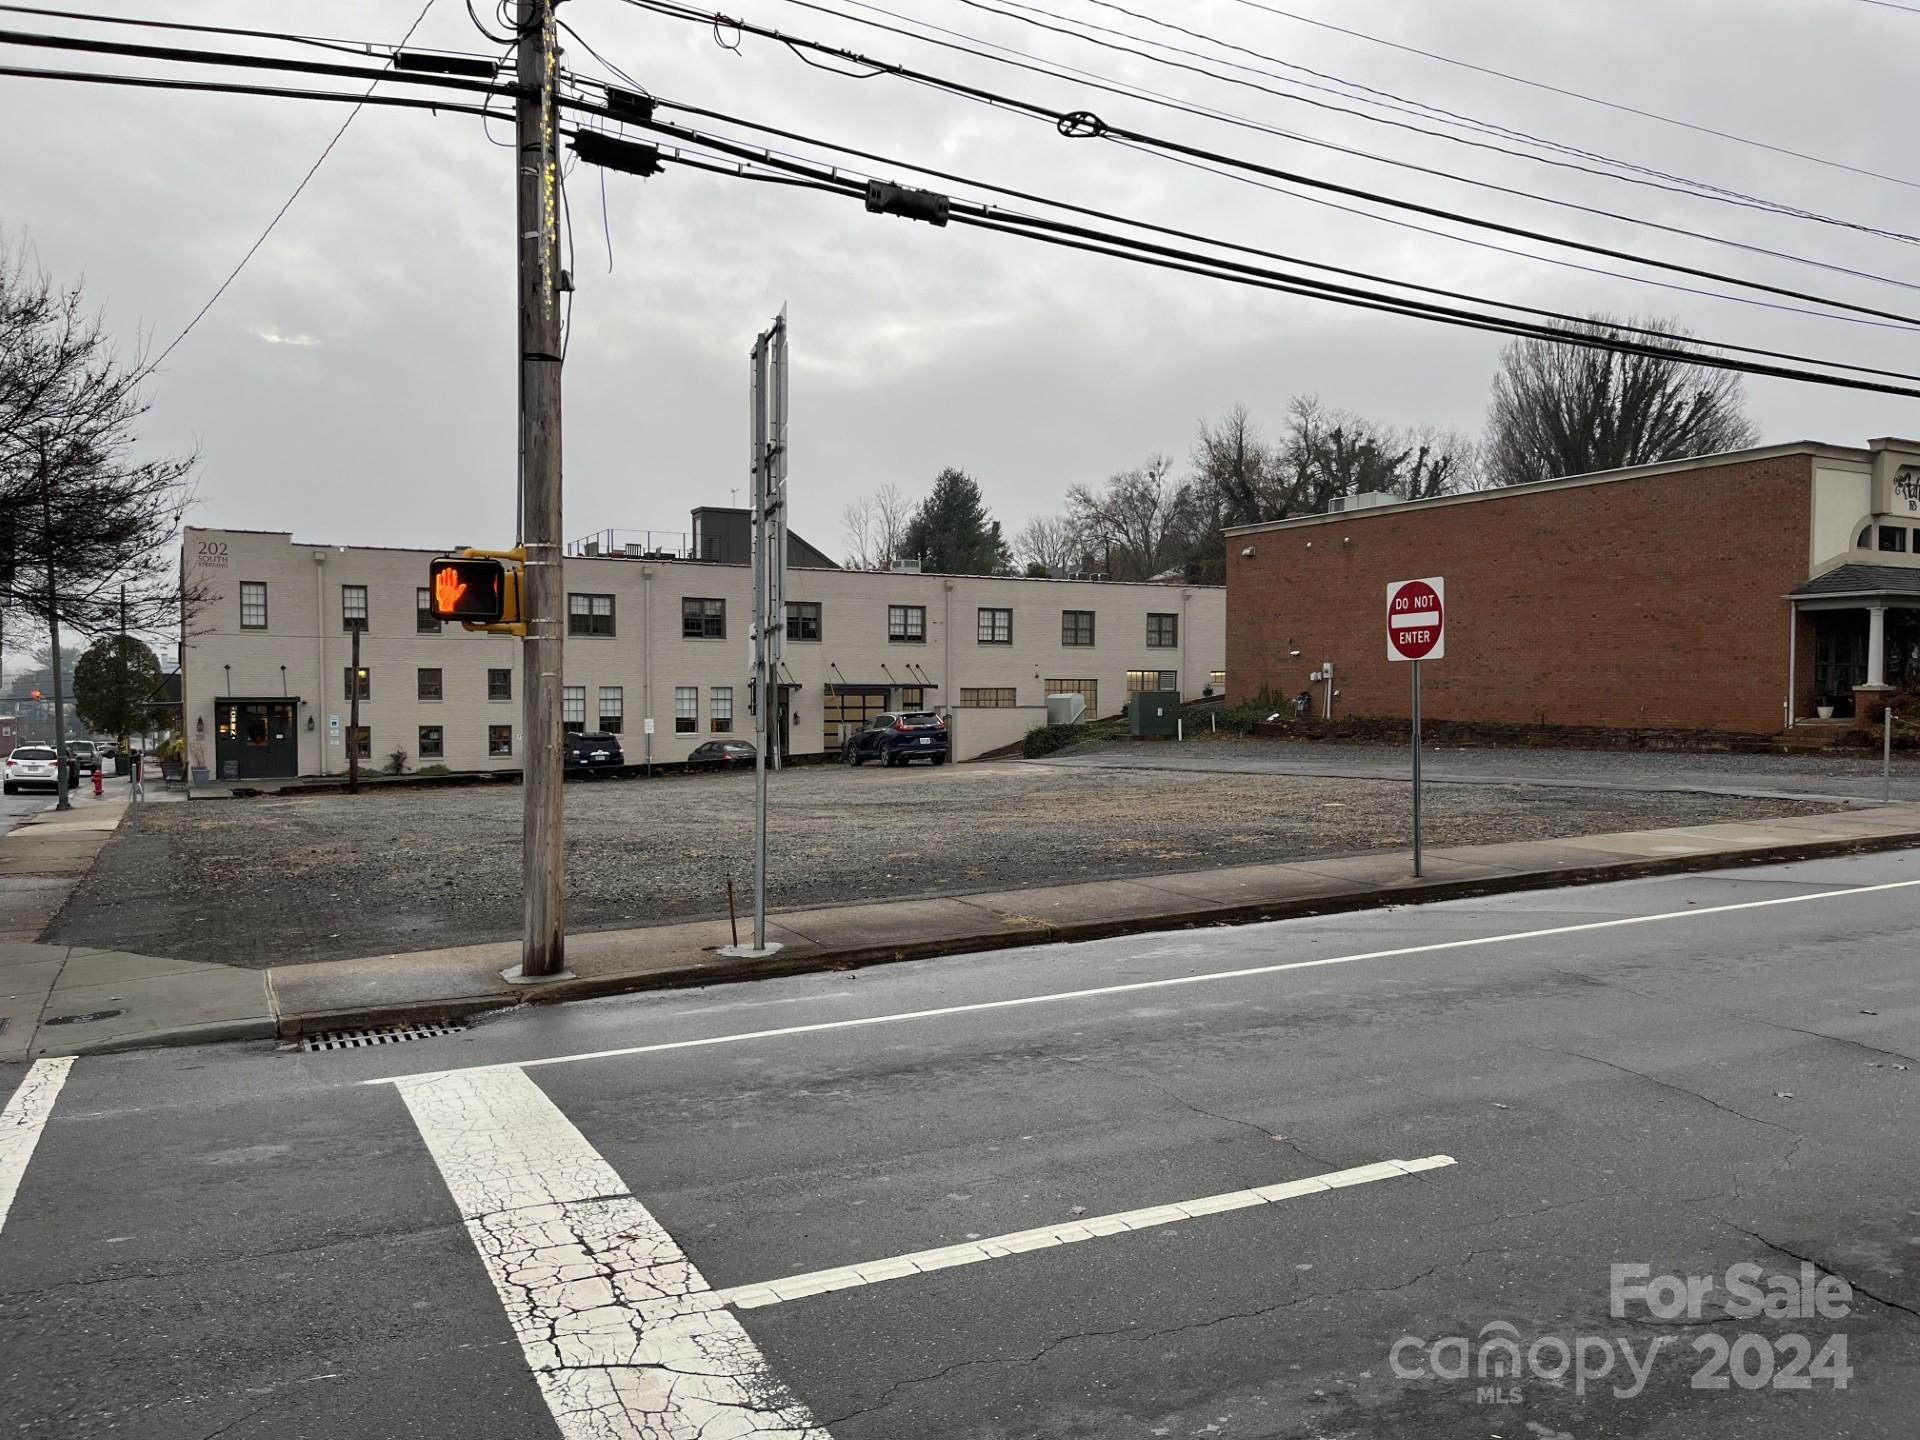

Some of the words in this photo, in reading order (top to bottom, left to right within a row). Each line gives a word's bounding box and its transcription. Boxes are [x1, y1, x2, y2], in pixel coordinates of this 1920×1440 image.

[198, 541, 229, 556] 202
[198, 555, 229, 563] SOUTH
[1395, 597, 1409, 610] DO
[1414, 594, 1435, 609] NOT
[1399, 630, 1430, 644] ENTER
